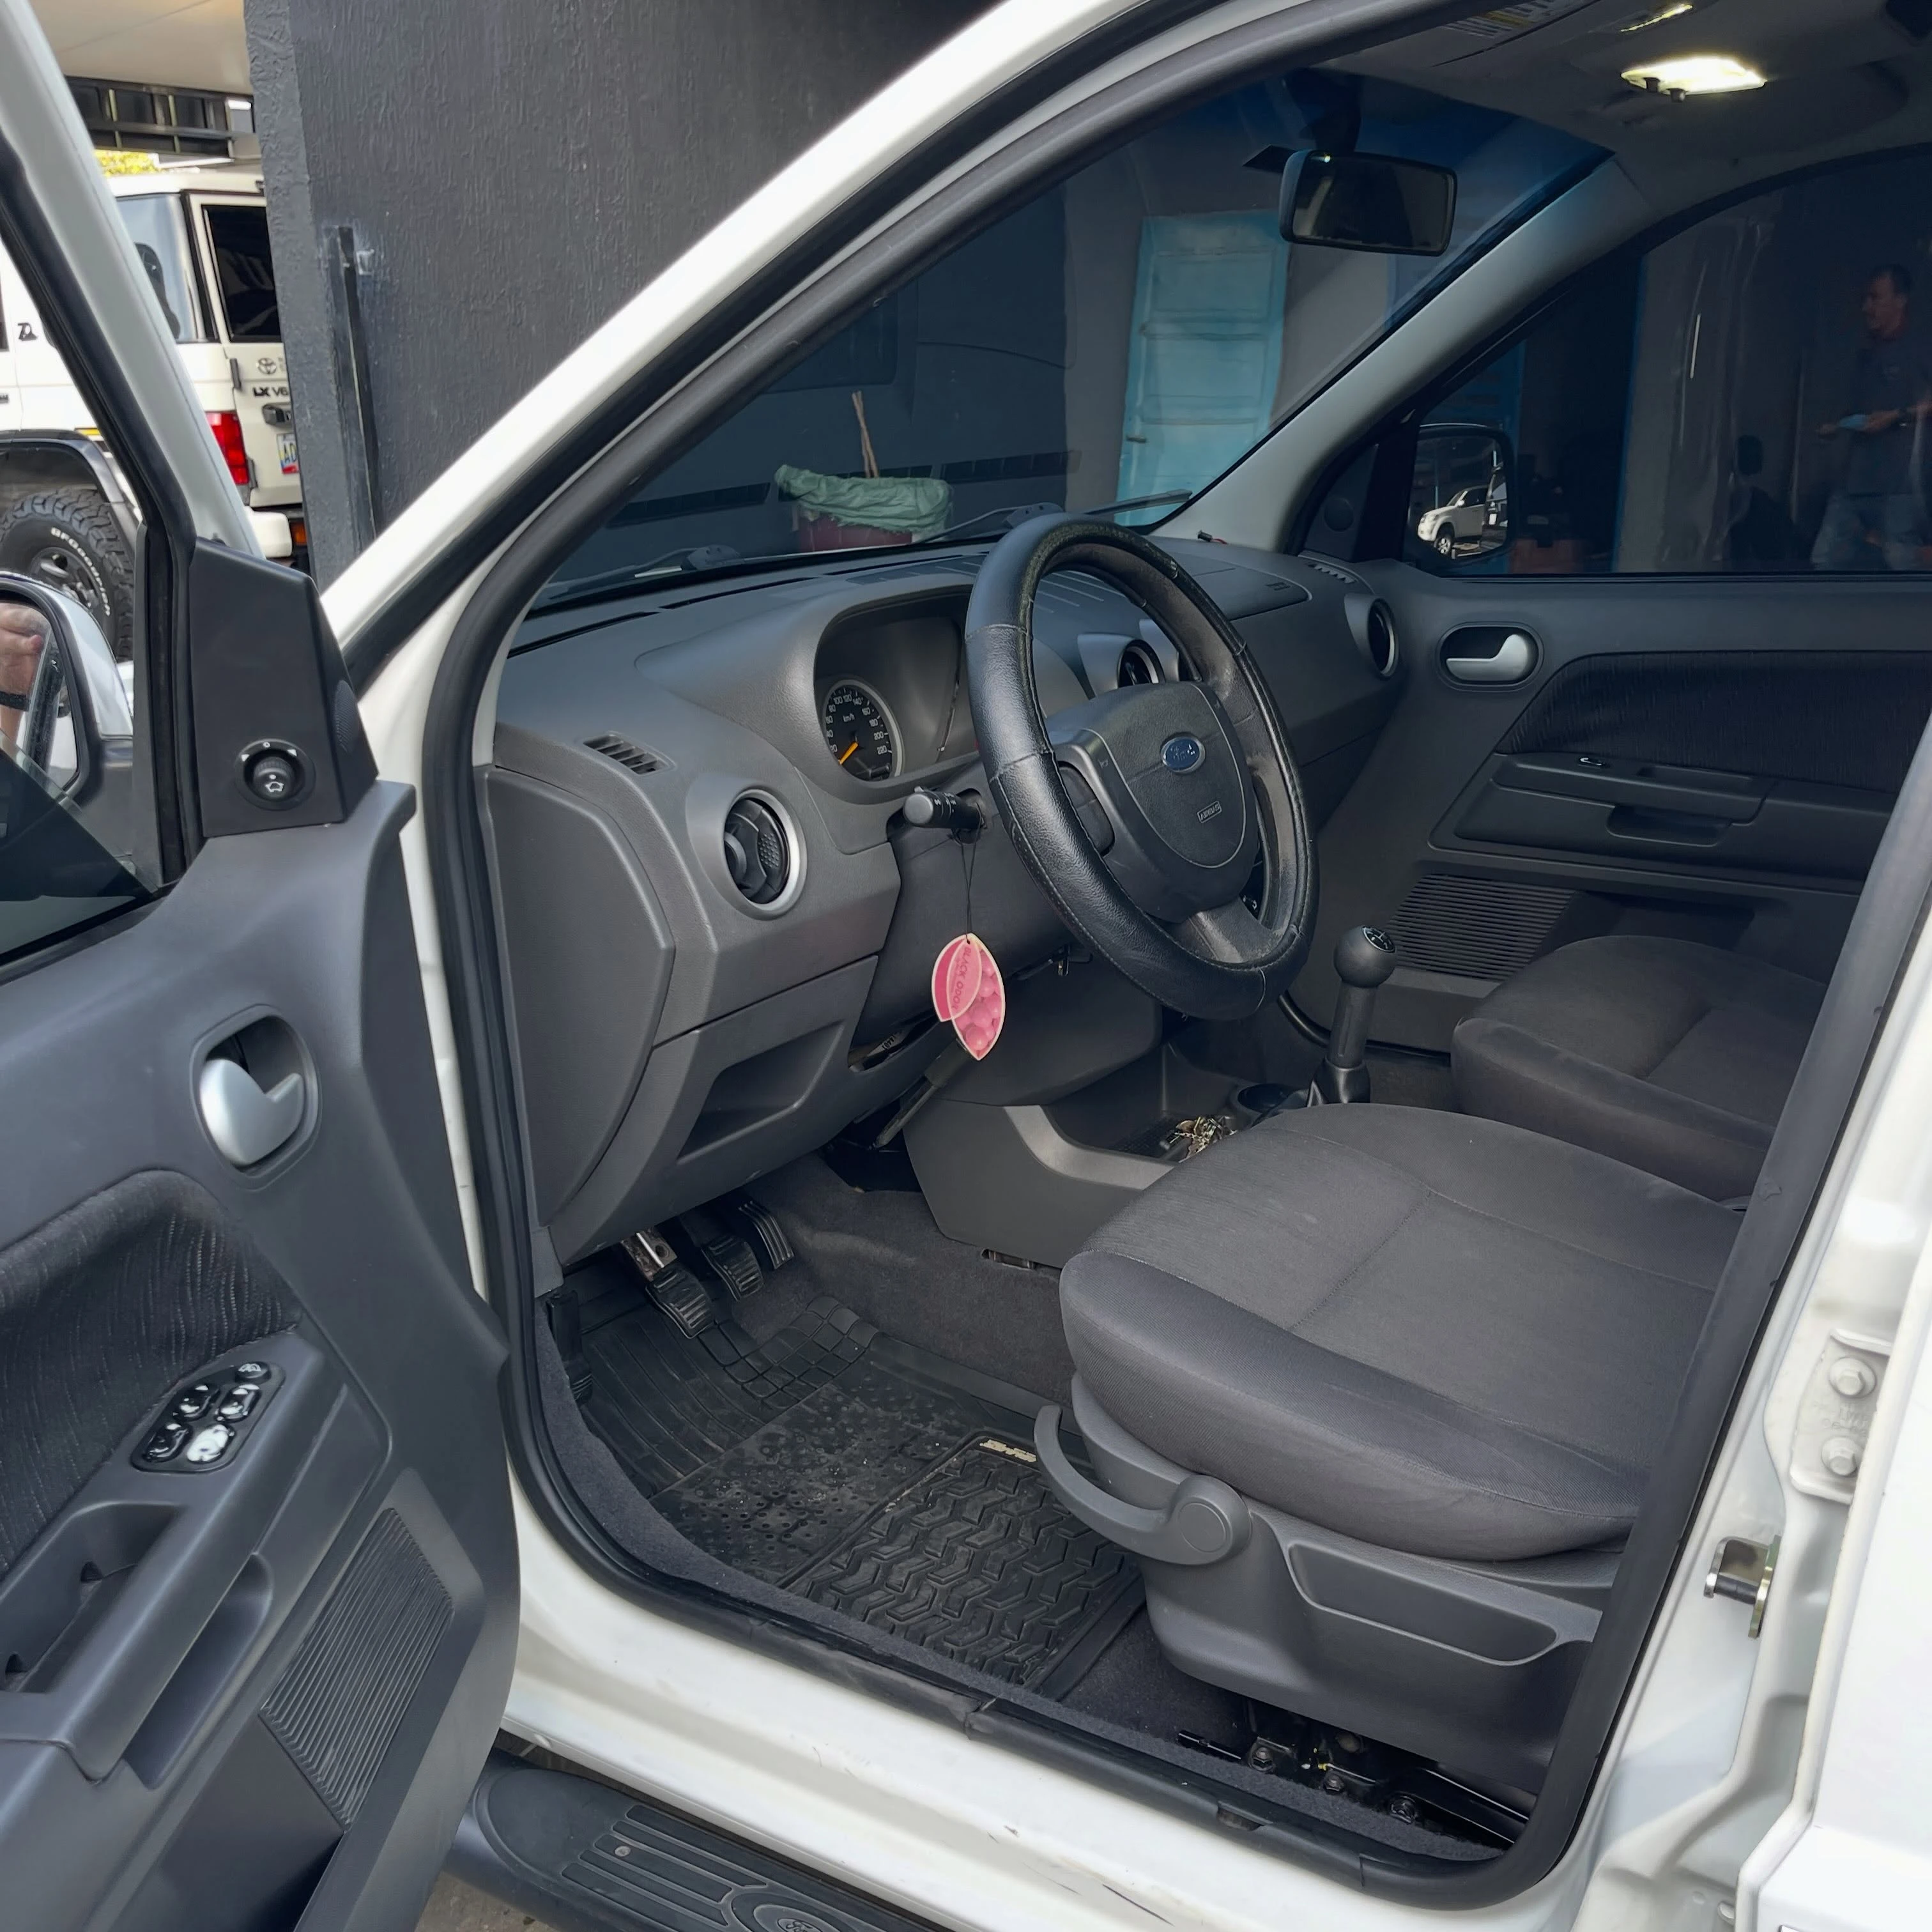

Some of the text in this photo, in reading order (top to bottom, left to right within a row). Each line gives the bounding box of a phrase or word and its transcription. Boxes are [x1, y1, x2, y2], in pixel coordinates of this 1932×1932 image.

[834, 696, 843, 705] 100
[843, 694, 852, 703] 120
[870, 719, 878, 727] 180
[874, 731, 884, 740] 200
[877, 746, 887, 755] 220
[958, 947, 971, 979] BLACK
